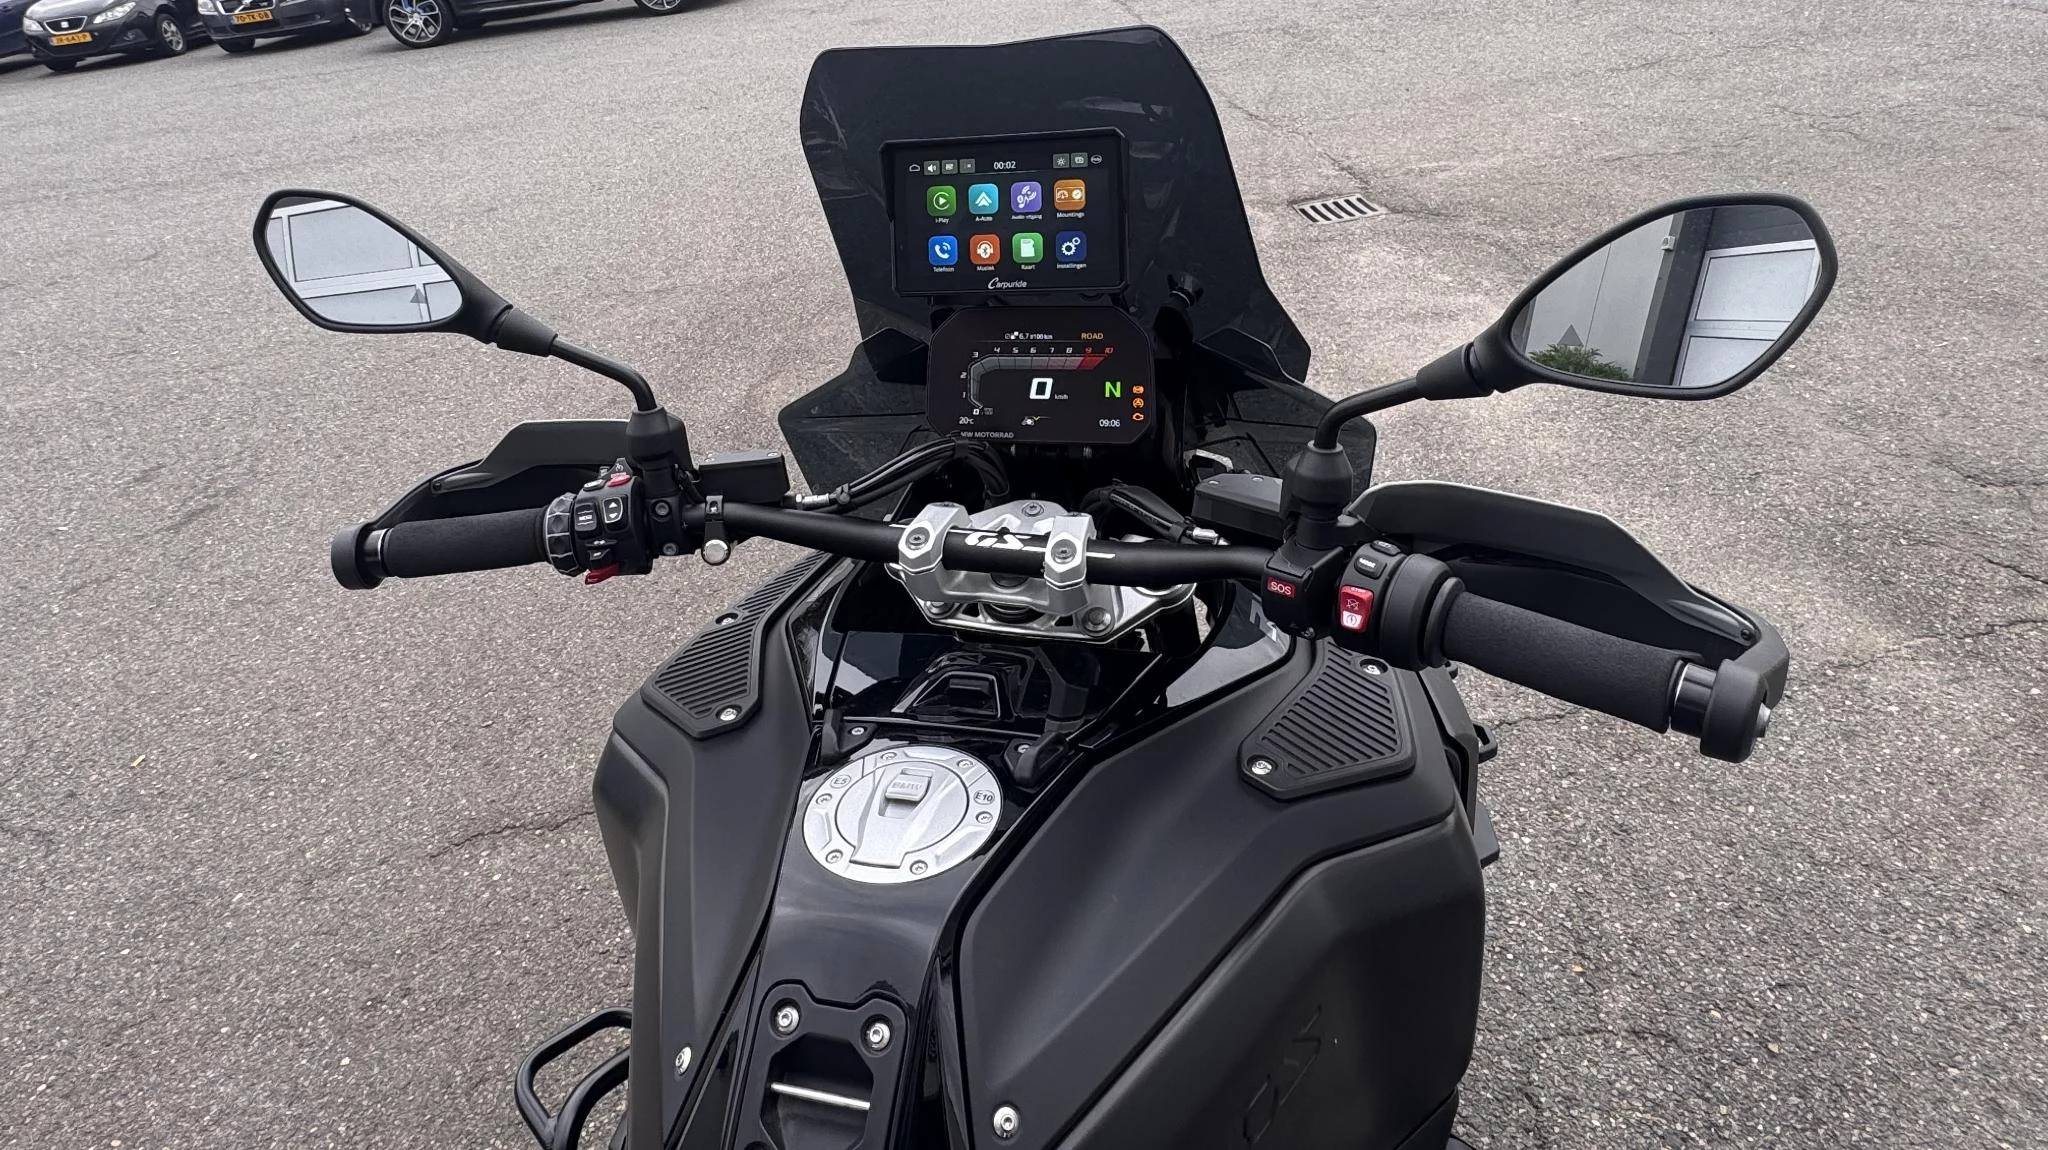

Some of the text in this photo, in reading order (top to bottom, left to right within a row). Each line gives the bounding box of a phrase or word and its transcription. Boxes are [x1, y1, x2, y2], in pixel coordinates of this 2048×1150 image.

[993, 161, 1017, 170] 00:02
[987, 277, 1028, 290] Carpuride
[1081, 332, 1104, 340] ROAD
[1012, 346, 1019, 354] 5
[1030, 346, 1037, 354] 6
[960, 371, 967, 379] 2
[1029, 377, 1054, 400] 0
[1104, 381, 1121, 398] N
[1098, 419, 1121, 427] 09:06
[974, 431, 1014, 439] MOTORRAD
[1270, 581, 1292, 595] SOS
[833, 777, 848, 785] E5
[975, 792, 994, 802] E10
